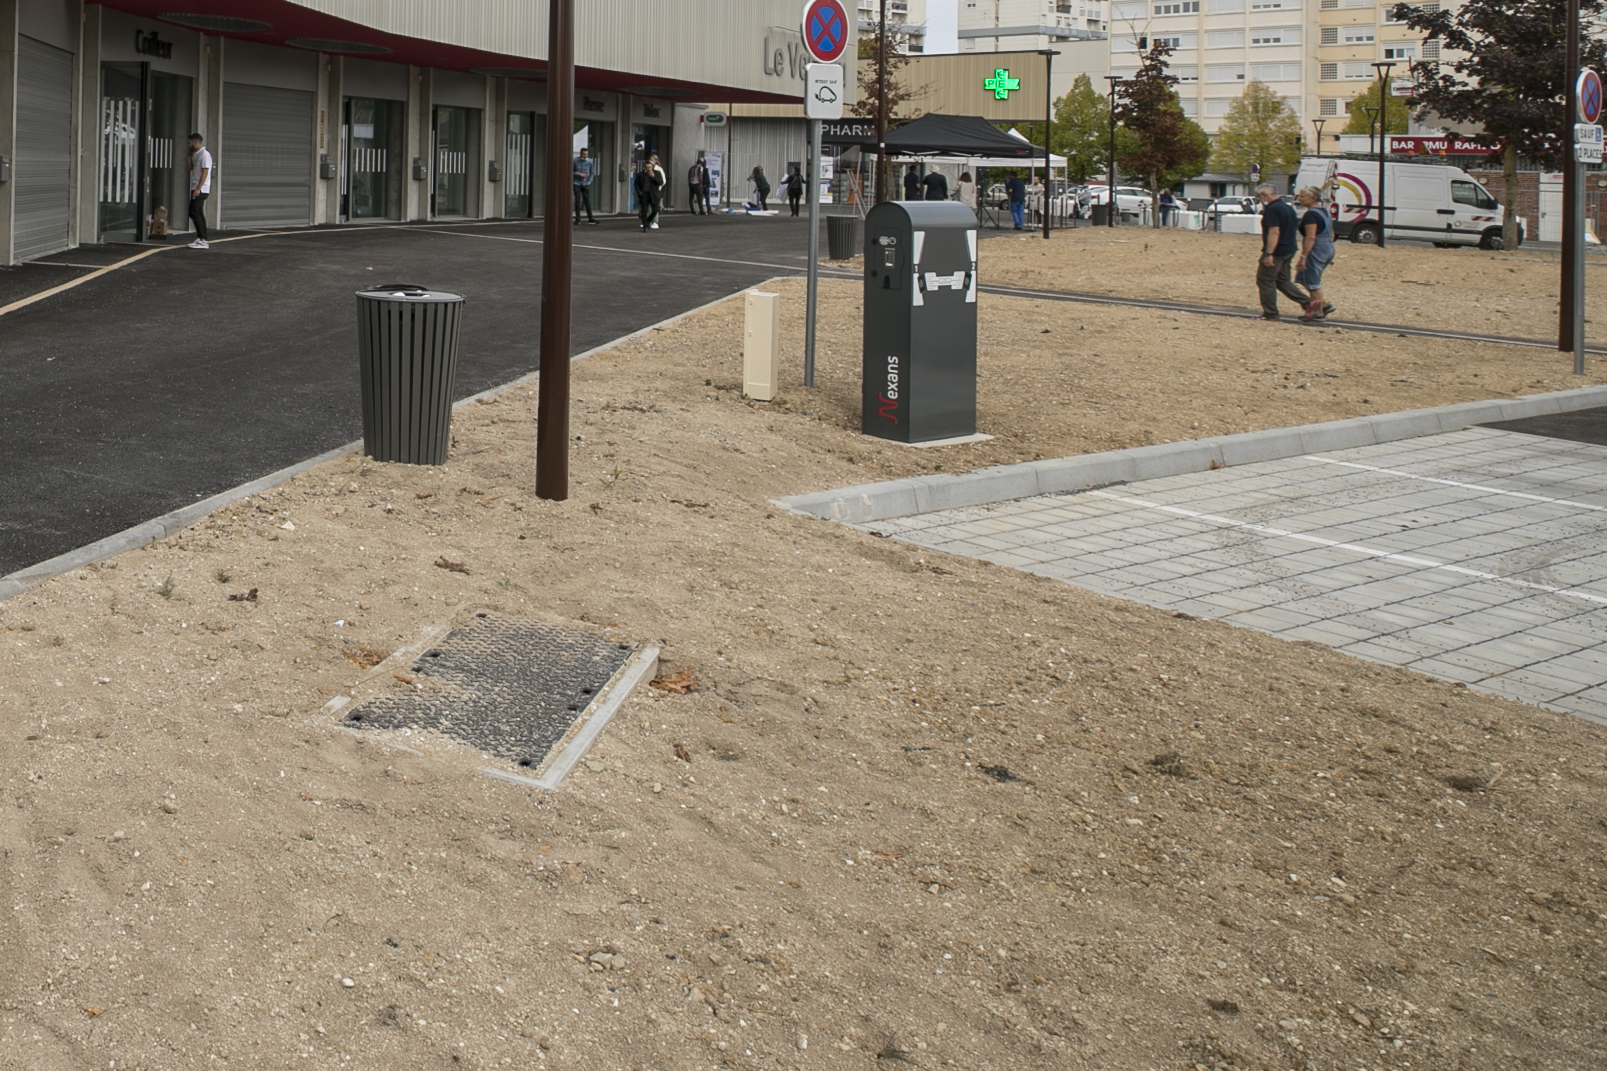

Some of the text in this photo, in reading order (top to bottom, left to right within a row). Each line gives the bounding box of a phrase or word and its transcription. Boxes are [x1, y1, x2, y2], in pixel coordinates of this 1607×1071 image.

[764, 36, 784, 76] Le
[1580, 128, 1595, 139] SAUF
[1392, 140, 1415, 149] BAR
[1578, 147, 1602, 160] 2 PLACES
